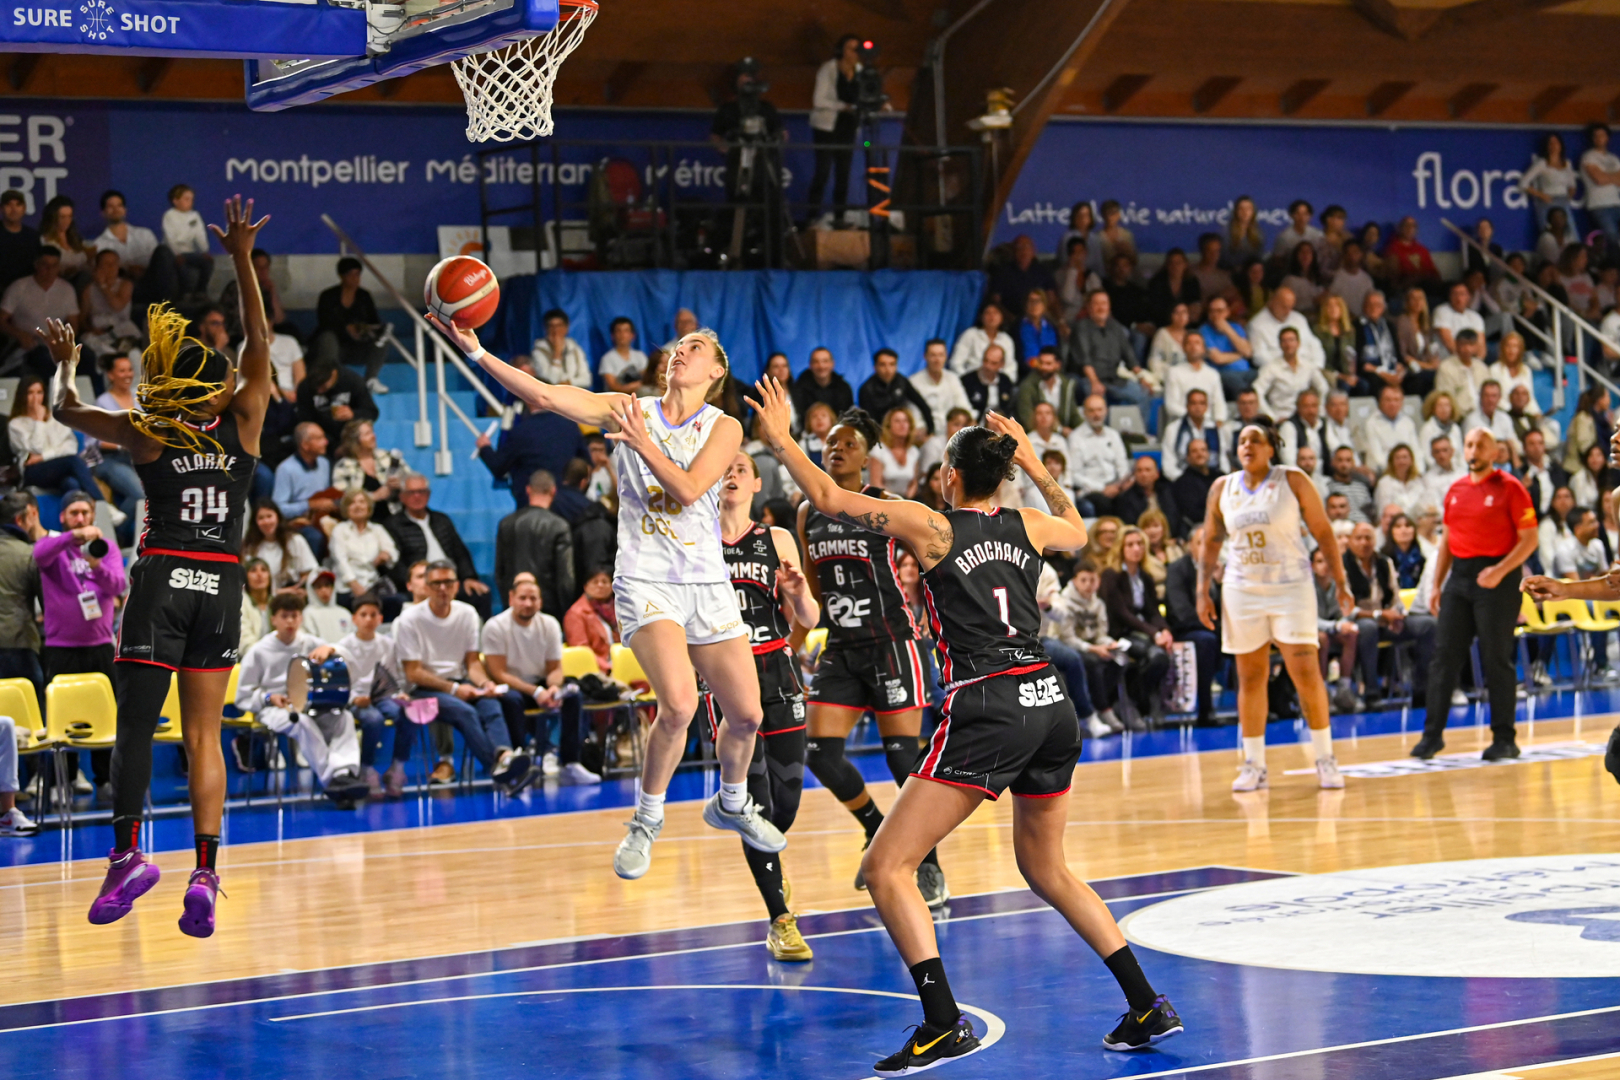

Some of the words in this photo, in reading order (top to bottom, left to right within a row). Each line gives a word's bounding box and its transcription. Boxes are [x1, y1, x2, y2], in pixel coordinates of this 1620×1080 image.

[13, 7, 73, 27] SURE
[120, 13, 181, 34] SHOT
[79, 23, 115, 41] SHOT
[226, 154, 410, 188] Montpellier
[1005, 201, 1072, 225] Latte
[171, 453, 237, 473] CLARKE
[181, 486, 229, 523] 34
[808, 540, 868, 561] FLAMMES
[1246, 530, 1266, 549] 13
[955, 541, 1030, 575] BROCHANT
[727, 562, 769, 586] MMES
[834, 565, 845, 586] 6
[992, 586, 1018, 638] 1
